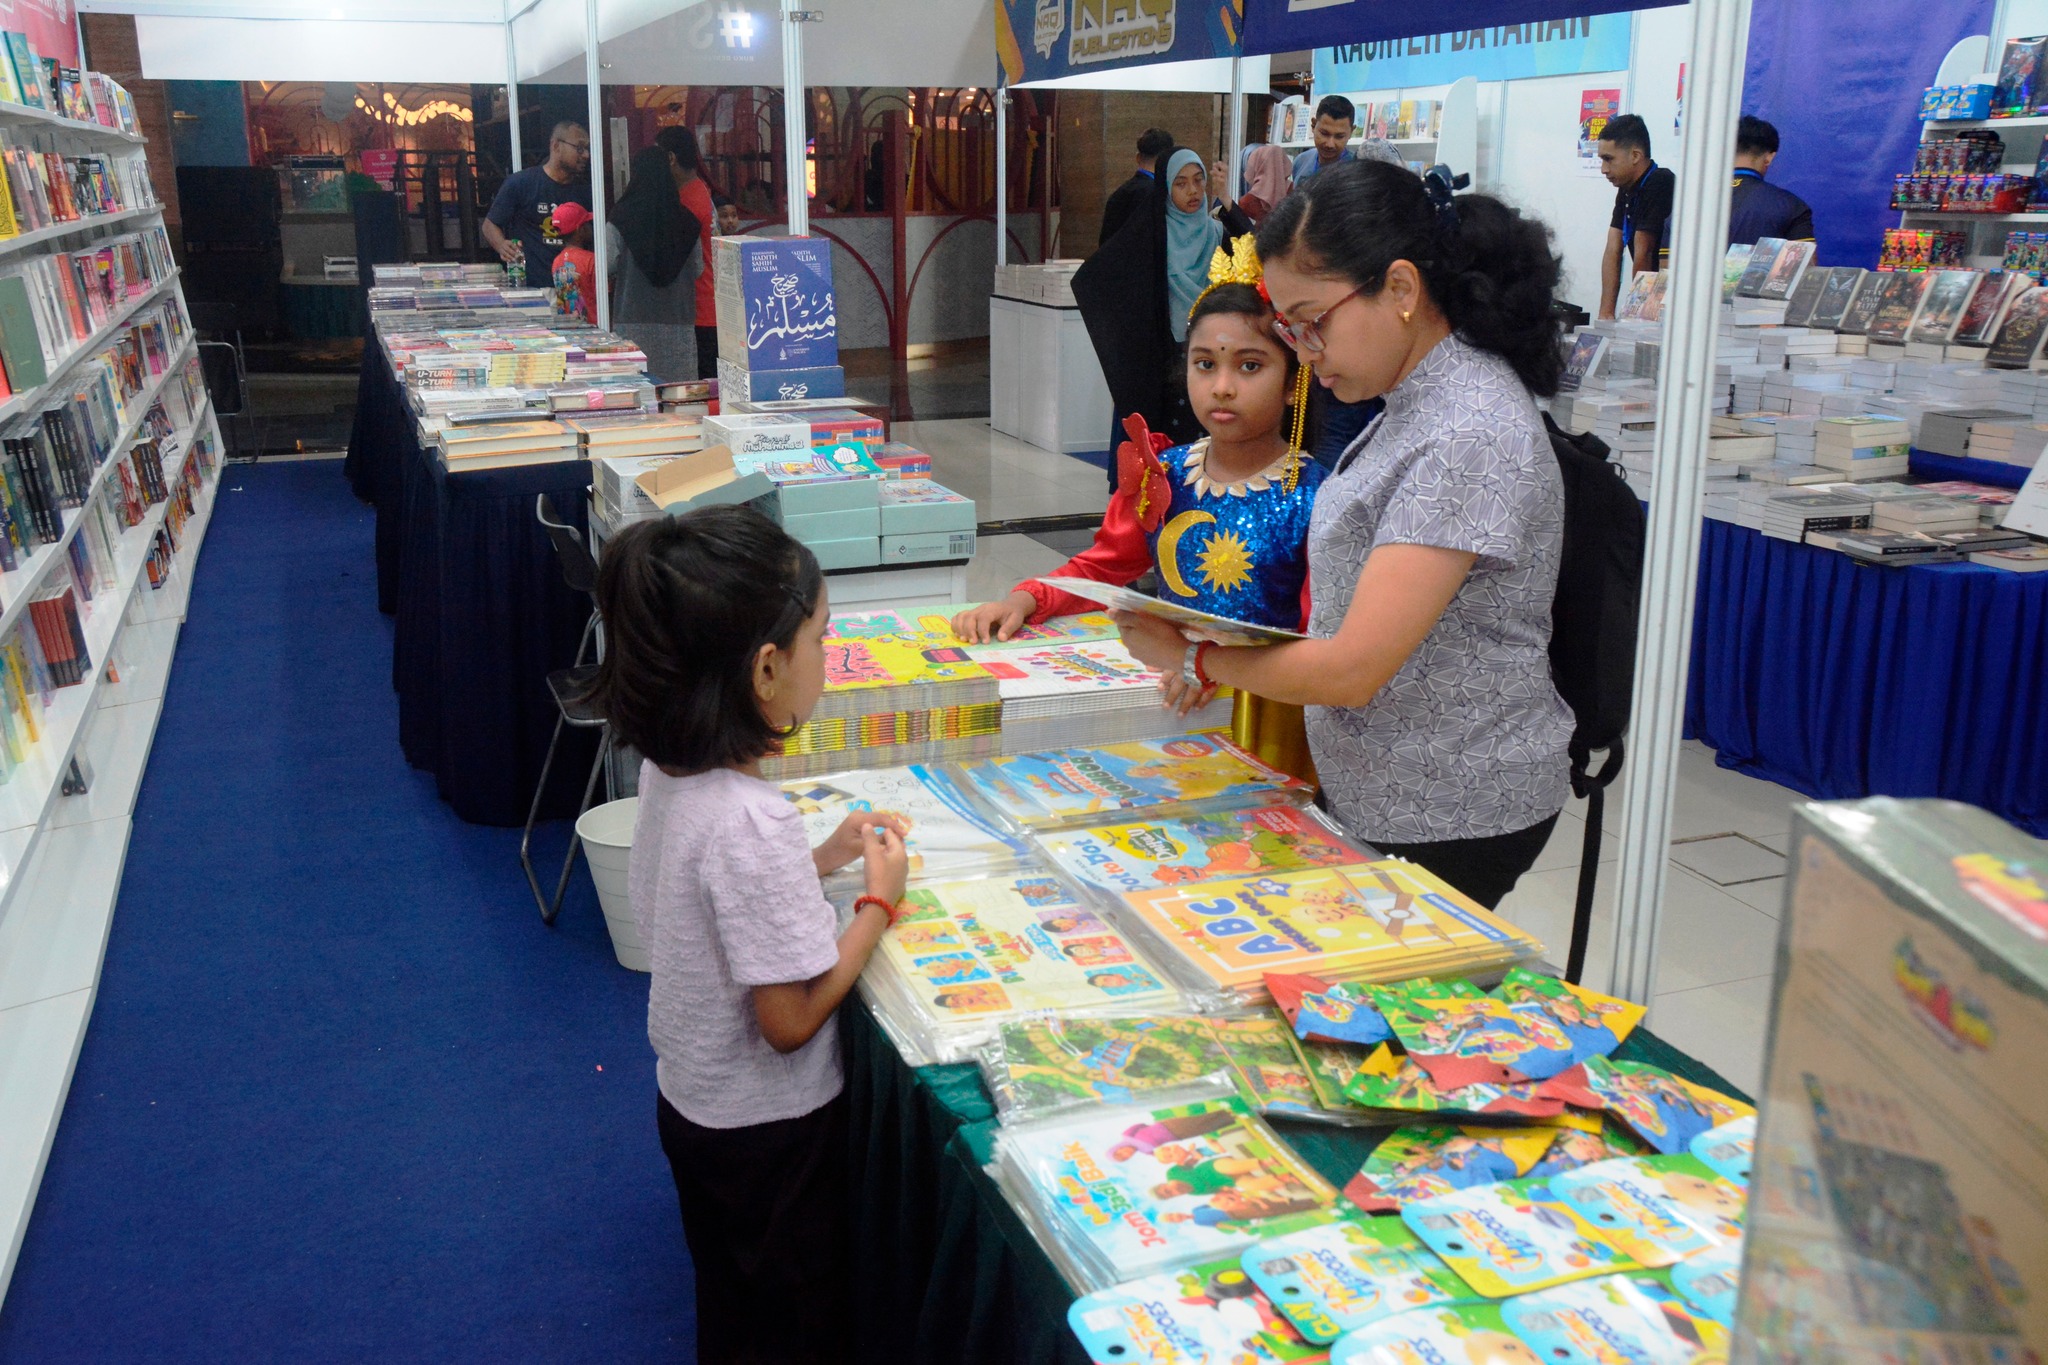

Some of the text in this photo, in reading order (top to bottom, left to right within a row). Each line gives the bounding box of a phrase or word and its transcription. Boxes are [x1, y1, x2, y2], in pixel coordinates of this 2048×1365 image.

[1072, 24, 1173, 57] PUBLICATIONS
[417, 370, 453, 378] U-TURN
[417, 378, 453, 386] U-TURN
[1068, 755, 1147, 799] NOMBOR
[1073, 838, 1109, 866] Dot
[1187, 897, 1299, 956] ABC
[1061, 1140, 1168, 1248] Jom Jadi Baik
[1283, 1300, 1342, 1338] CLAY
